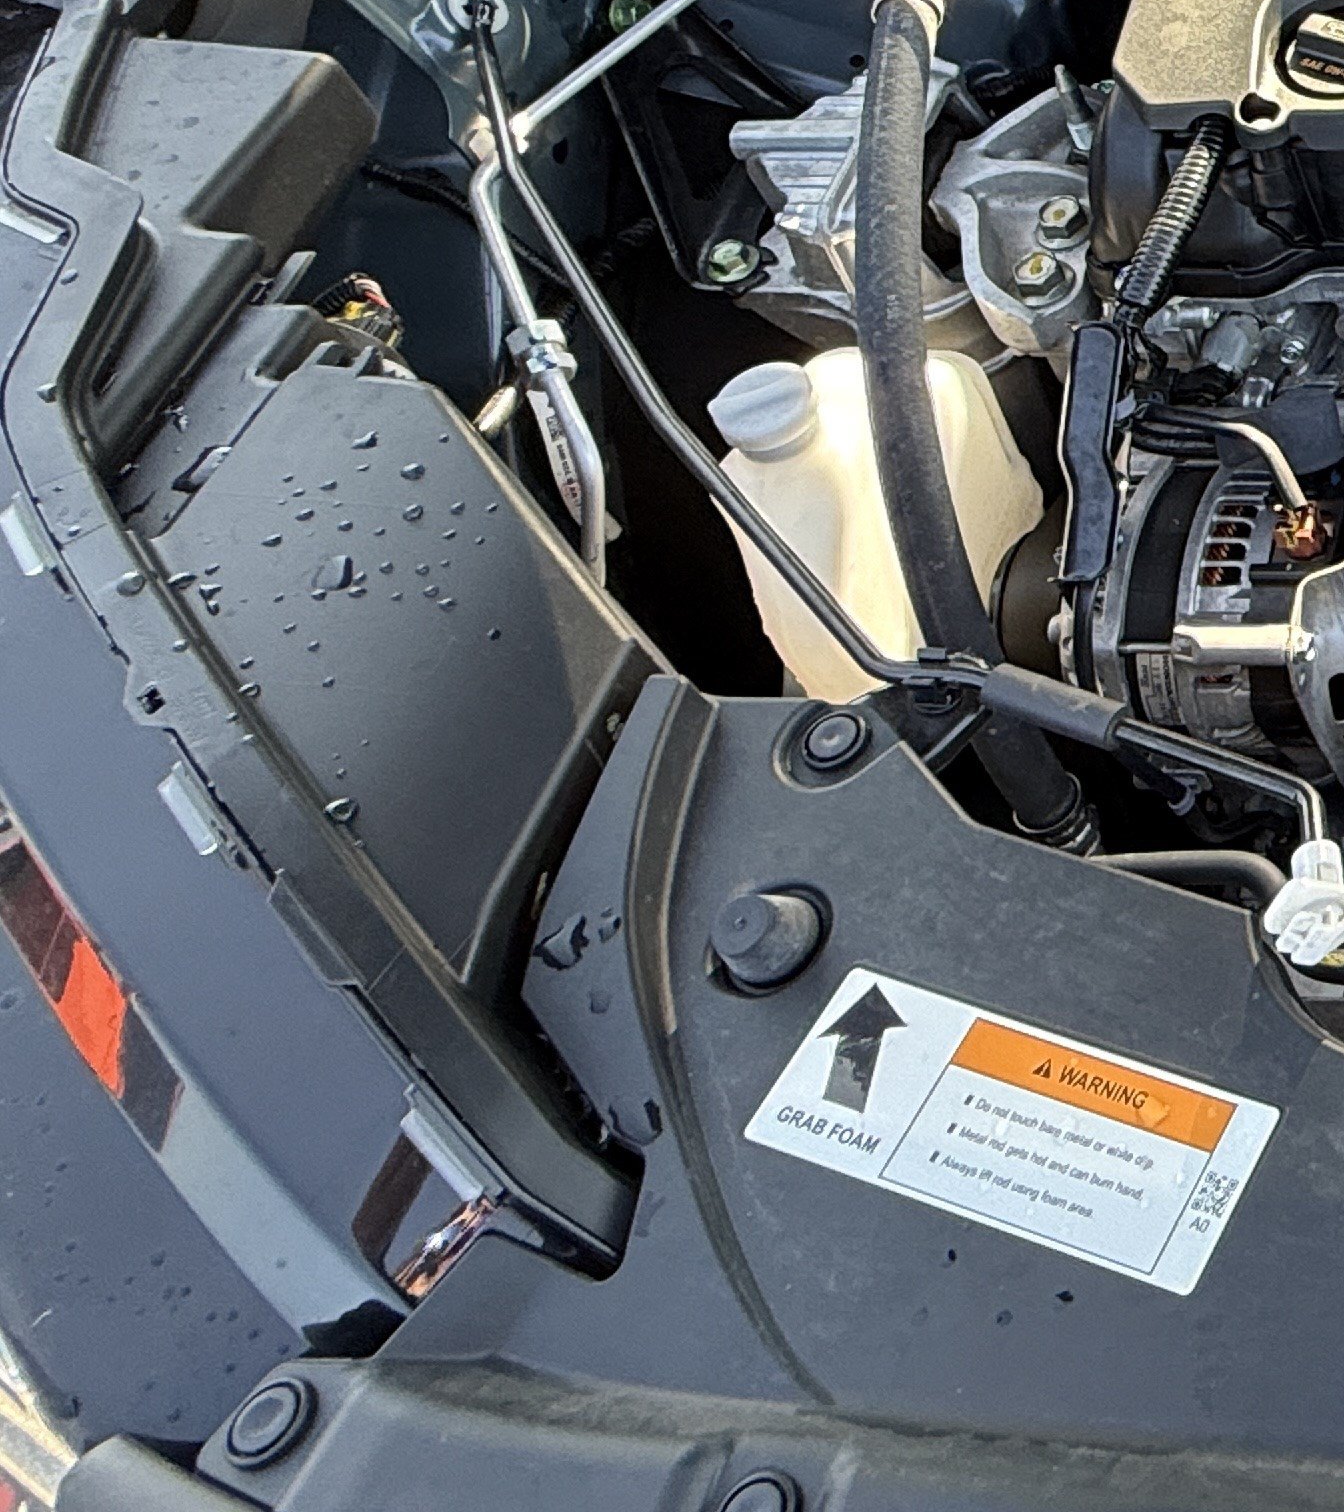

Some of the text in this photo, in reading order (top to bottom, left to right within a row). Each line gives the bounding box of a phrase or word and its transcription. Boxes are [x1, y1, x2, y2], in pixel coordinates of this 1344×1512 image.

[1058, 1064, 1149, 1110] WARNING
[776, 1105, 882, 1156] GRAB FOAM
[975, 1098, 992, 1113] Do
[991, 1106, 1011, 1120] not
[1009, 1110, 1039, 1128] touch
[1038, 1120, 1063, 1138] bare
[1063, 1131, 1093, 1148] metal
[1092, 1141, 1106, 1152] or
[941, 1155, 978, 1178] Always
[978, 1168, 993, 1181] lift
[992, 1175, 1012, 1189] rod
[1011, 1182, 1040, 1202] using
[1040, 1189, 1068, 1209] foam
[958, 1126, 988, 1144] Metal
[988, 1137, 1007, 1152] rod
[1004, 1145, 1030, 1161] gets
[1030, 1152, 1049, 1167] hot
[1047, 1159, 1070, 1175] and
[1069, 1167, 1089, 1181] can
[1089, 1172, 1114, 1191] burn
